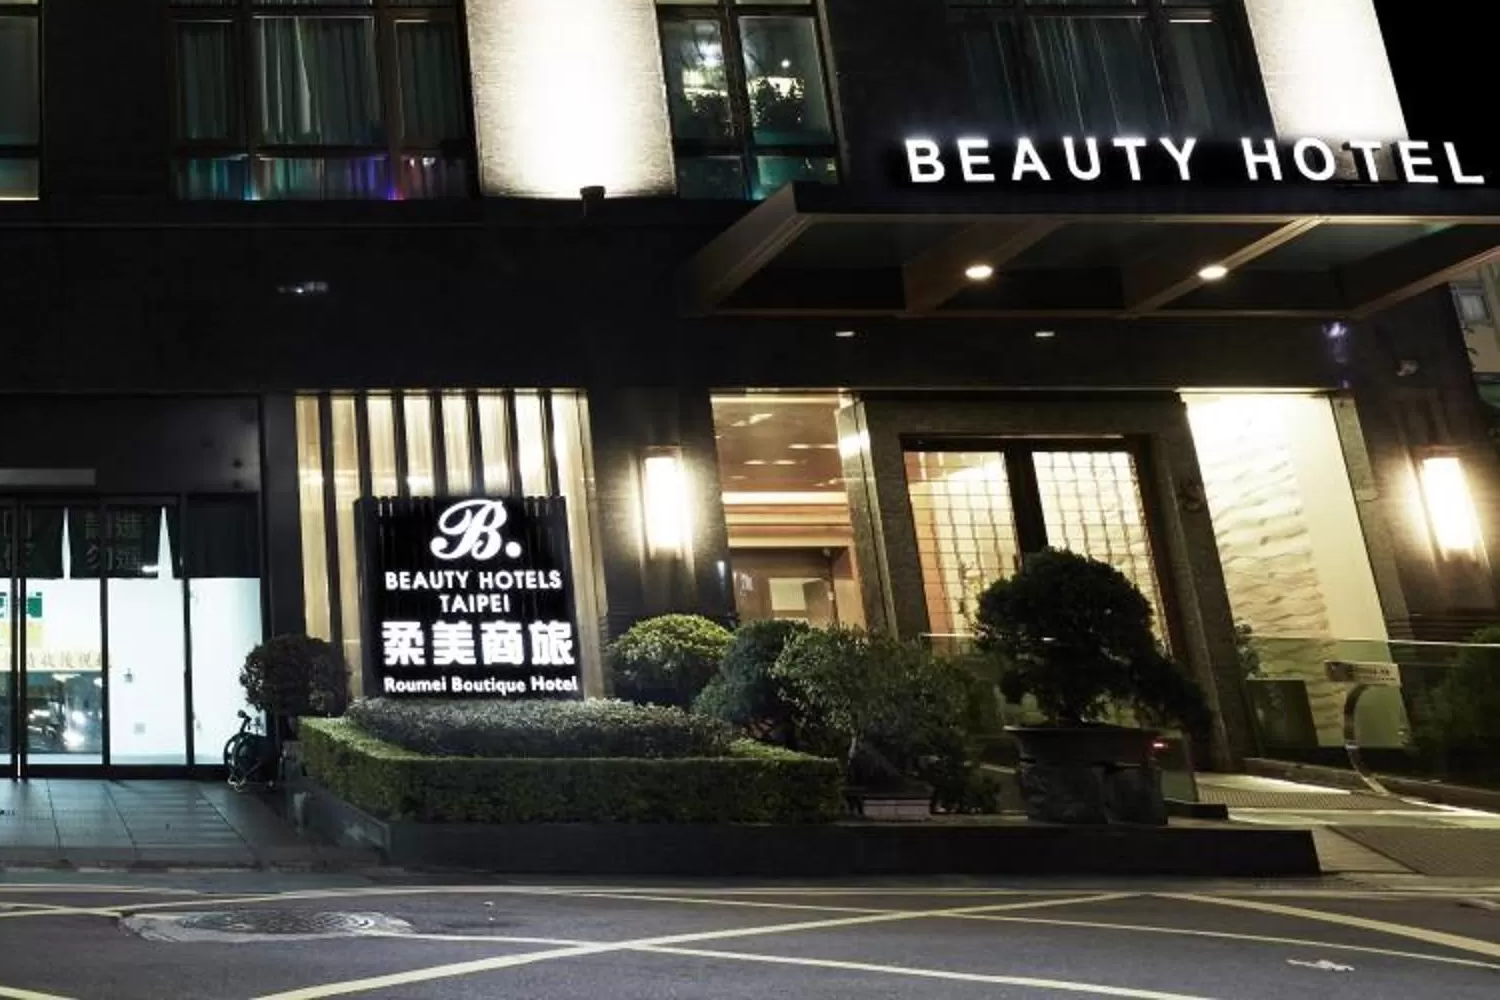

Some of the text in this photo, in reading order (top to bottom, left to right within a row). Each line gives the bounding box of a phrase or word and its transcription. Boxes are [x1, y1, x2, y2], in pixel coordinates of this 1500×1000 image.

[904, 136, 1486, 185] BEAUTY HOTEL
[385, 570, 562, 590] BEAUTY HOTELS
[439, 594, 510, 613] TAIPEI
[381, 620, 576, 666] 柔美商旅
[383, 675, 578, 696] Roumei Boutique Hotel
